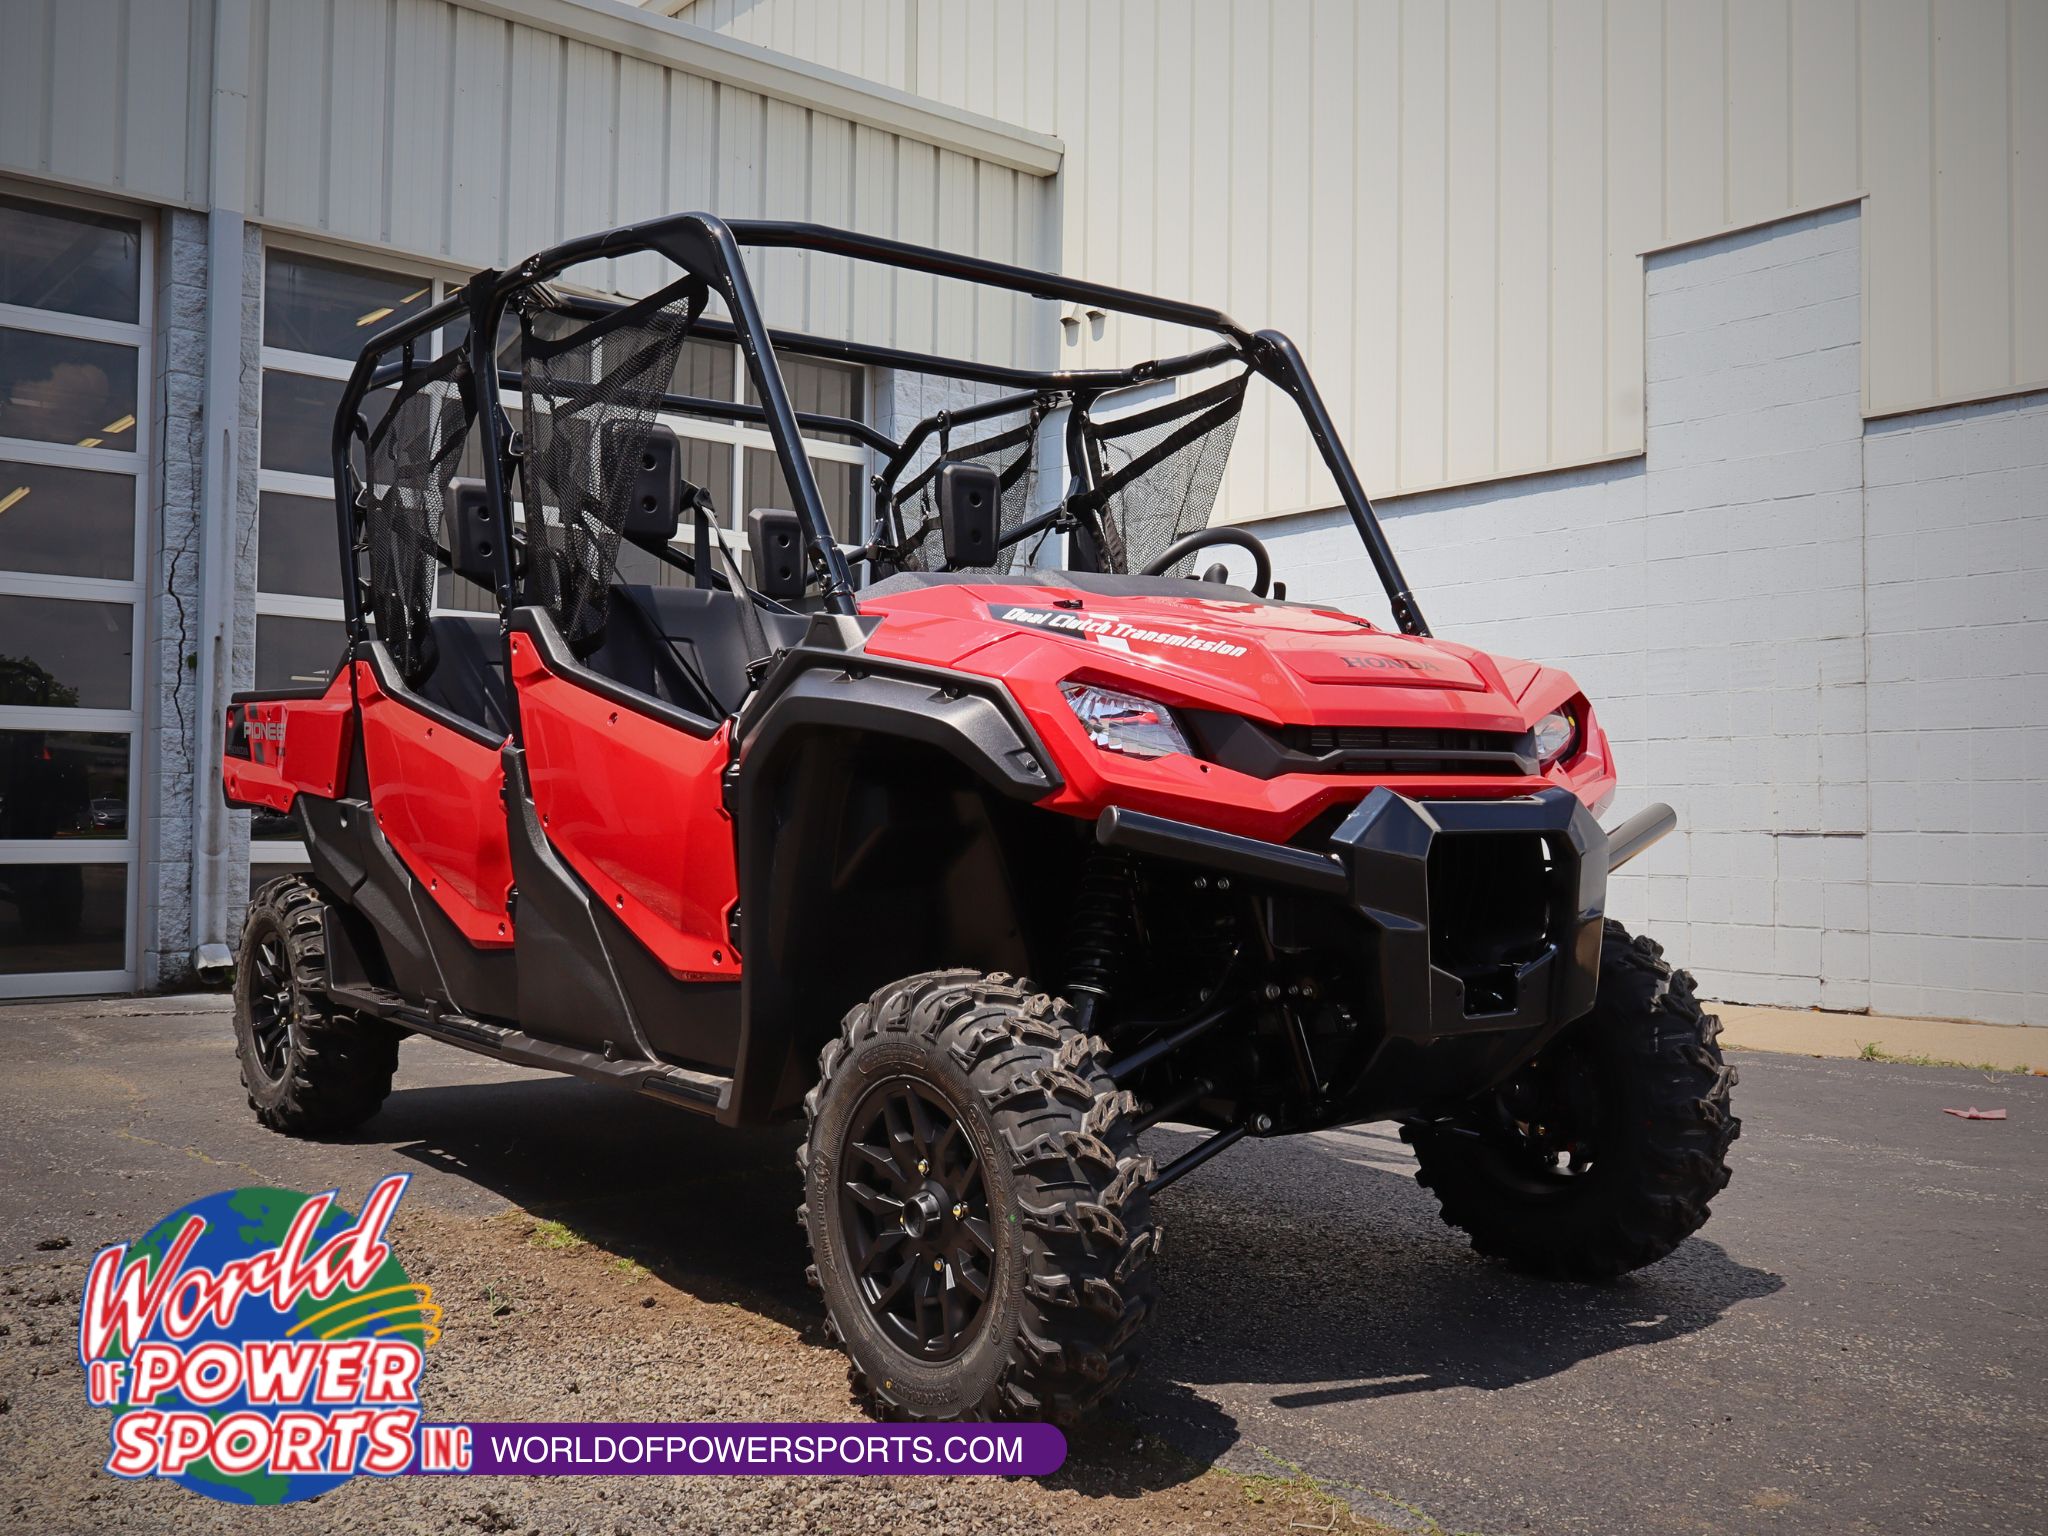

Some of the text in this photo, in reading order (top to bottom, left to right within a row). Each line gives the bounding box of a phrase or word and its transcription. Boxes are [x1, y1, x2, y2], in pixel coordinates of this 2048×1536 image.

[1002, 607, 1248, 657] Dual Clutch Transmission
[1340, 656, 1439, 672] HONDA
